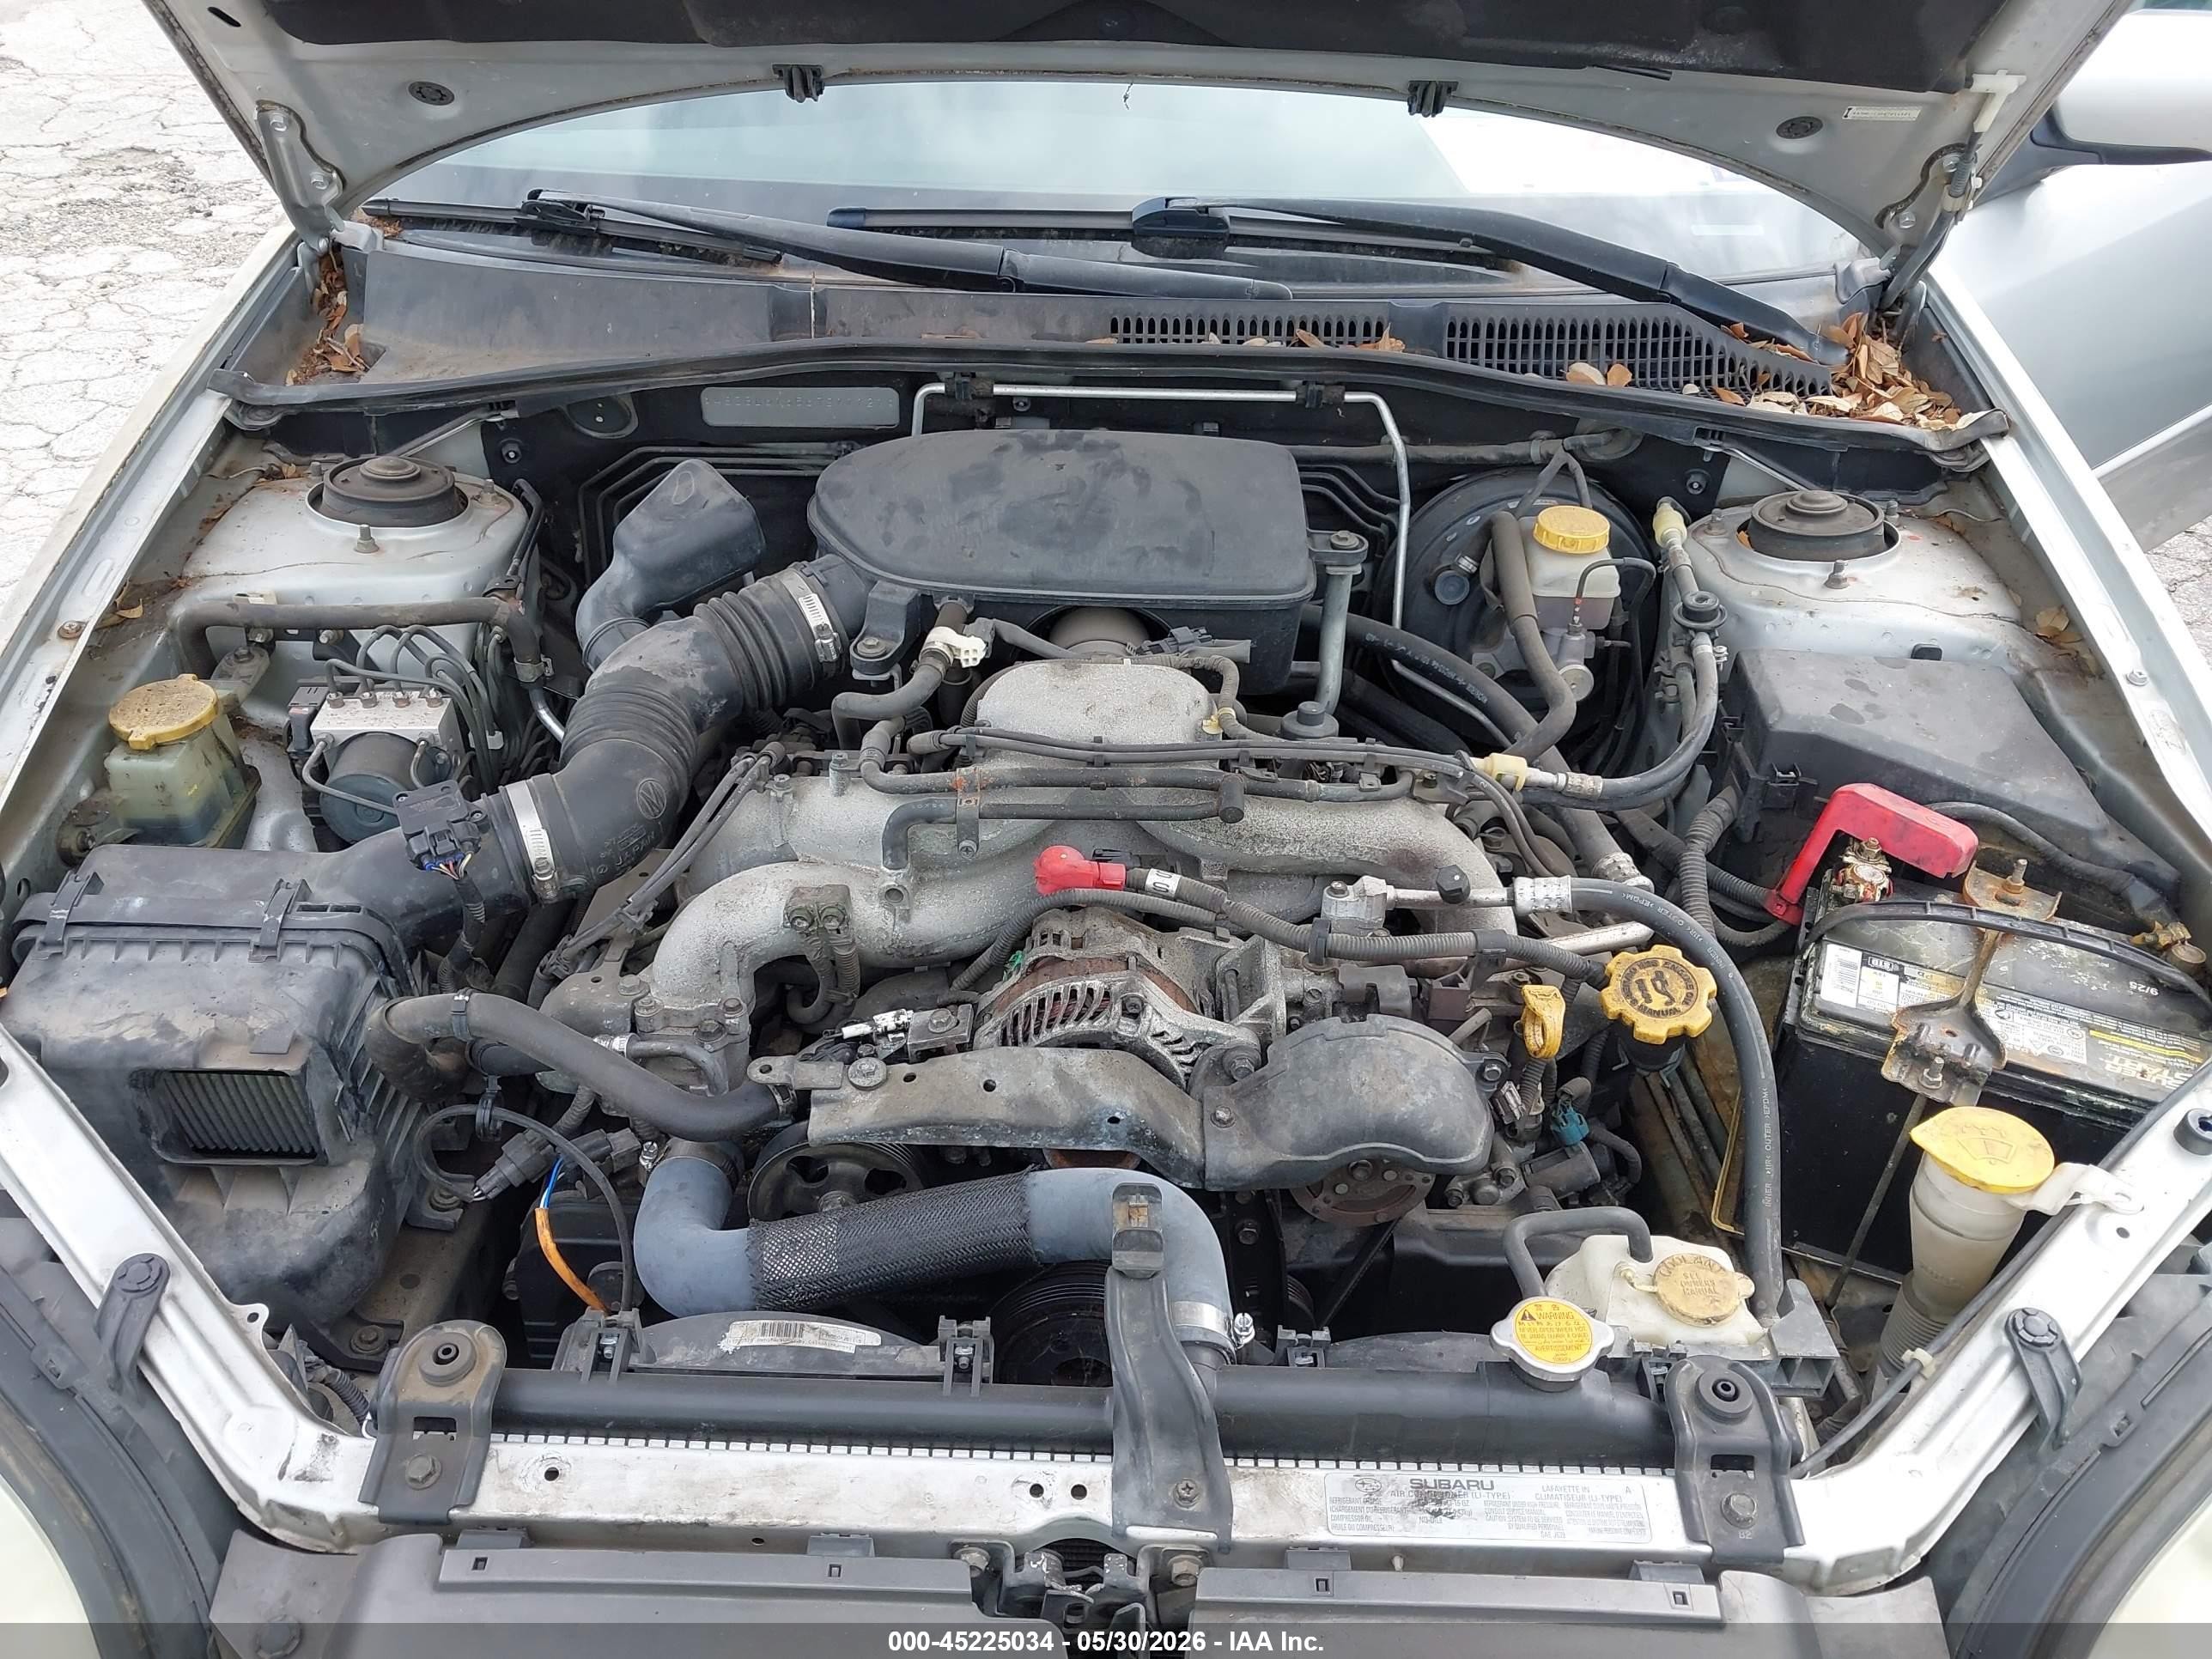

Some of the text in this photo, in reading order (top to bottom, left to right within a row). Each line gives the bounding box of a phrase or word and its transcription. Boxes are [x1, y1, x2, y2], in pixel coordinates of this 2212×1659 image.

[2129, 981, 2159, 996] 9/25
[1409, 1478, 1495, 1492] SUBARU
[1541, 1485, 1580, 1493] LAFAYETTE
[1534, 1492, 1589, 1501] CLIMATISEUR
